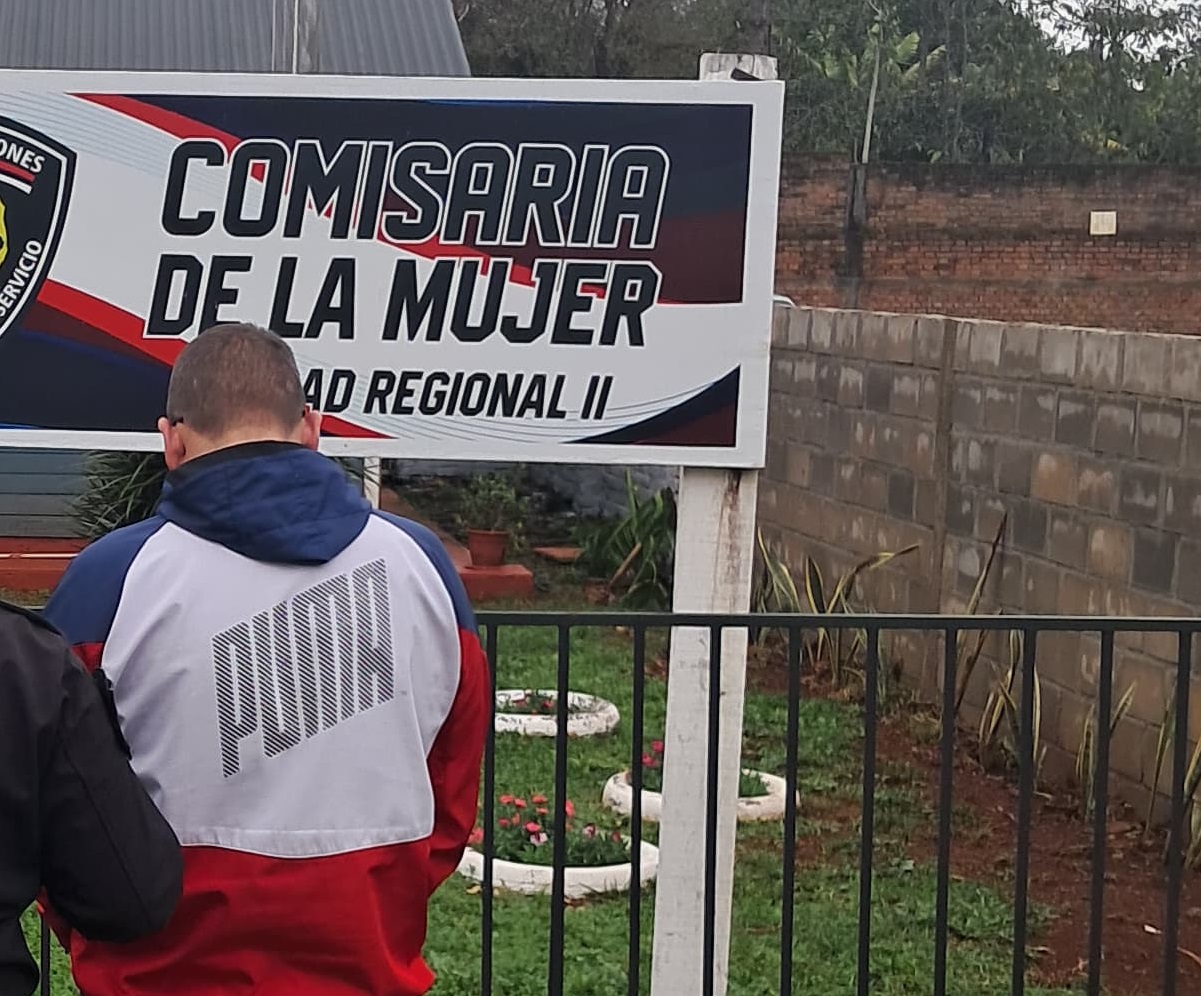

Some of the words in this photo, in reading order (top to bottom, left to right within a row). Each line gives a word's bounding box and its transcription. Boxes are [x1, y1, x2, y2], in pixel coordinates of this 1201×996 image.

[160, 140, 667, 248] COMISARIA
[147, 254, 253, 336] DE
[268, 256, 356, 340] LA
[382, 258, 659, 347] MUJER
[363, 370, 566, 419] REGIONAL
[581, 376, 614, 420] II
[211, 557, 395, 778] PUMA
